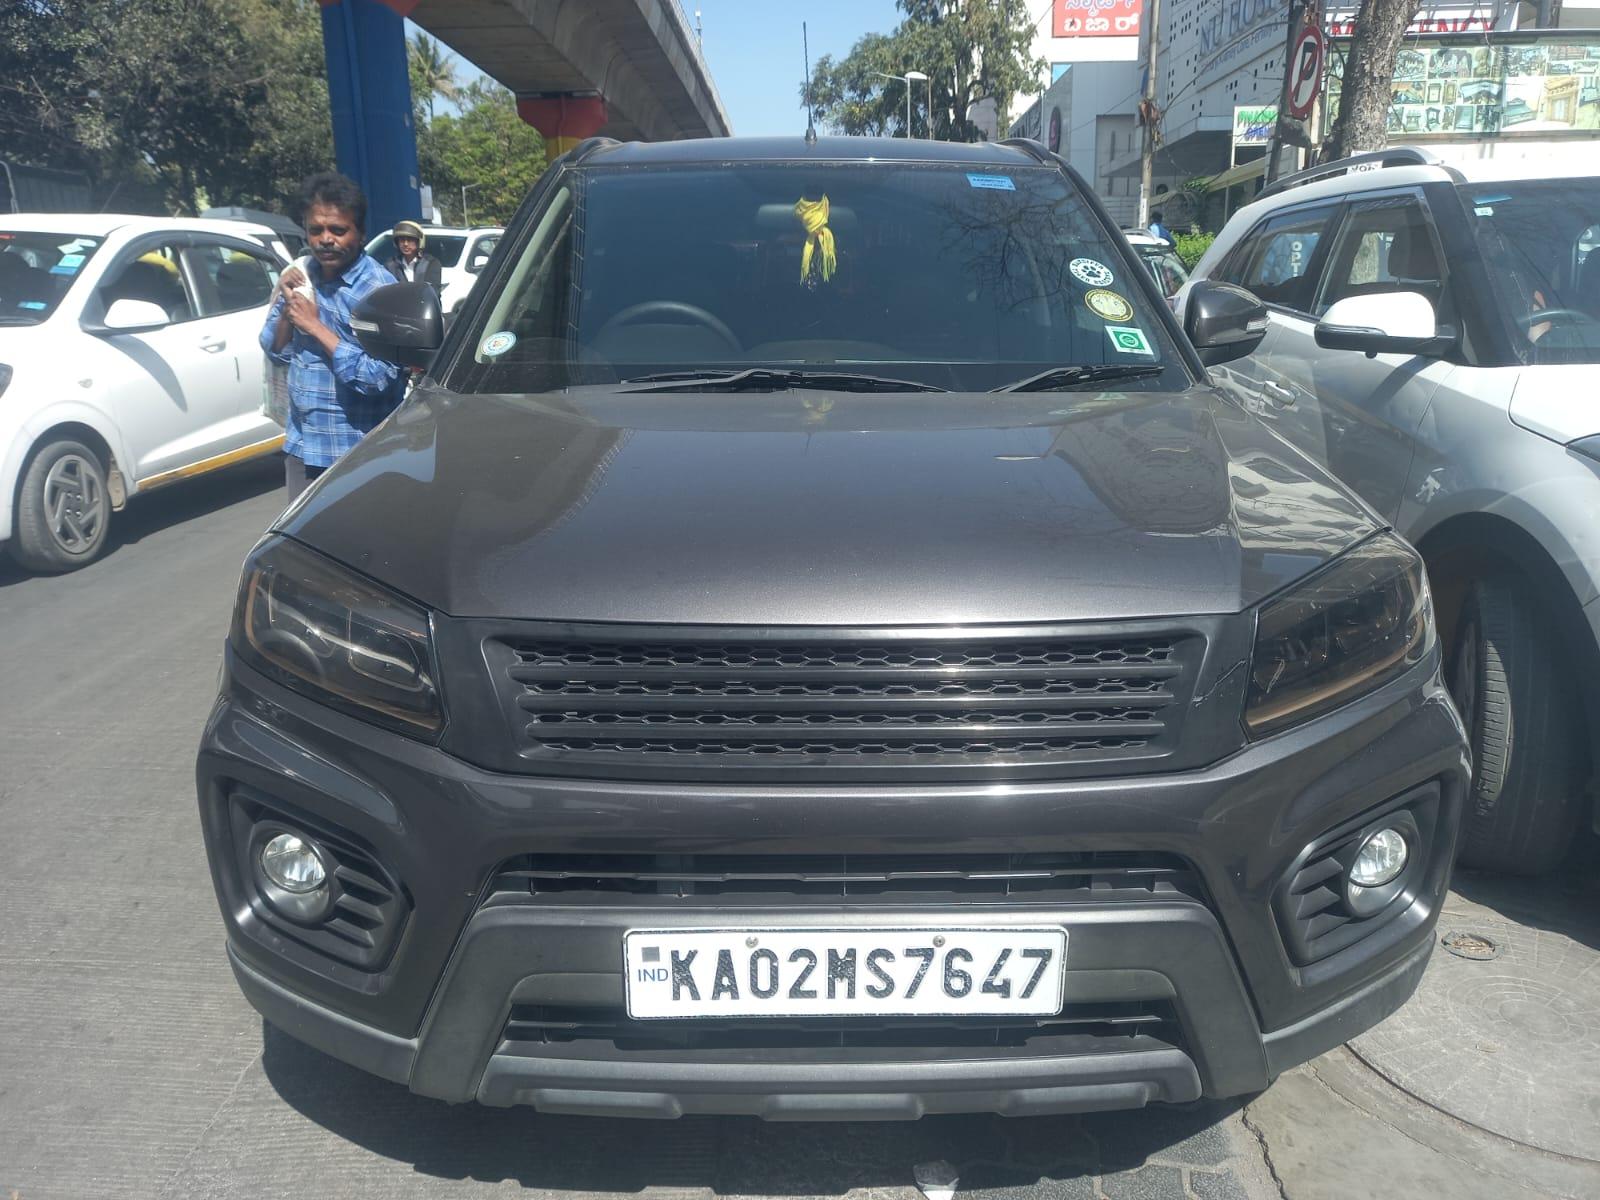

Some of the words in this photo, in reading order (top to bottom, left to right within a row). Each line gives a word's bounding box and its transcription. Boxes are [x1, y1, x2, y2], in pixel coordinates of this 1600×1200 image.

[1290, 240, 1303, 277] OPT
[637, 968, 669, 982] IND
[671, 947, 1053, 1001] KA02MS7647
